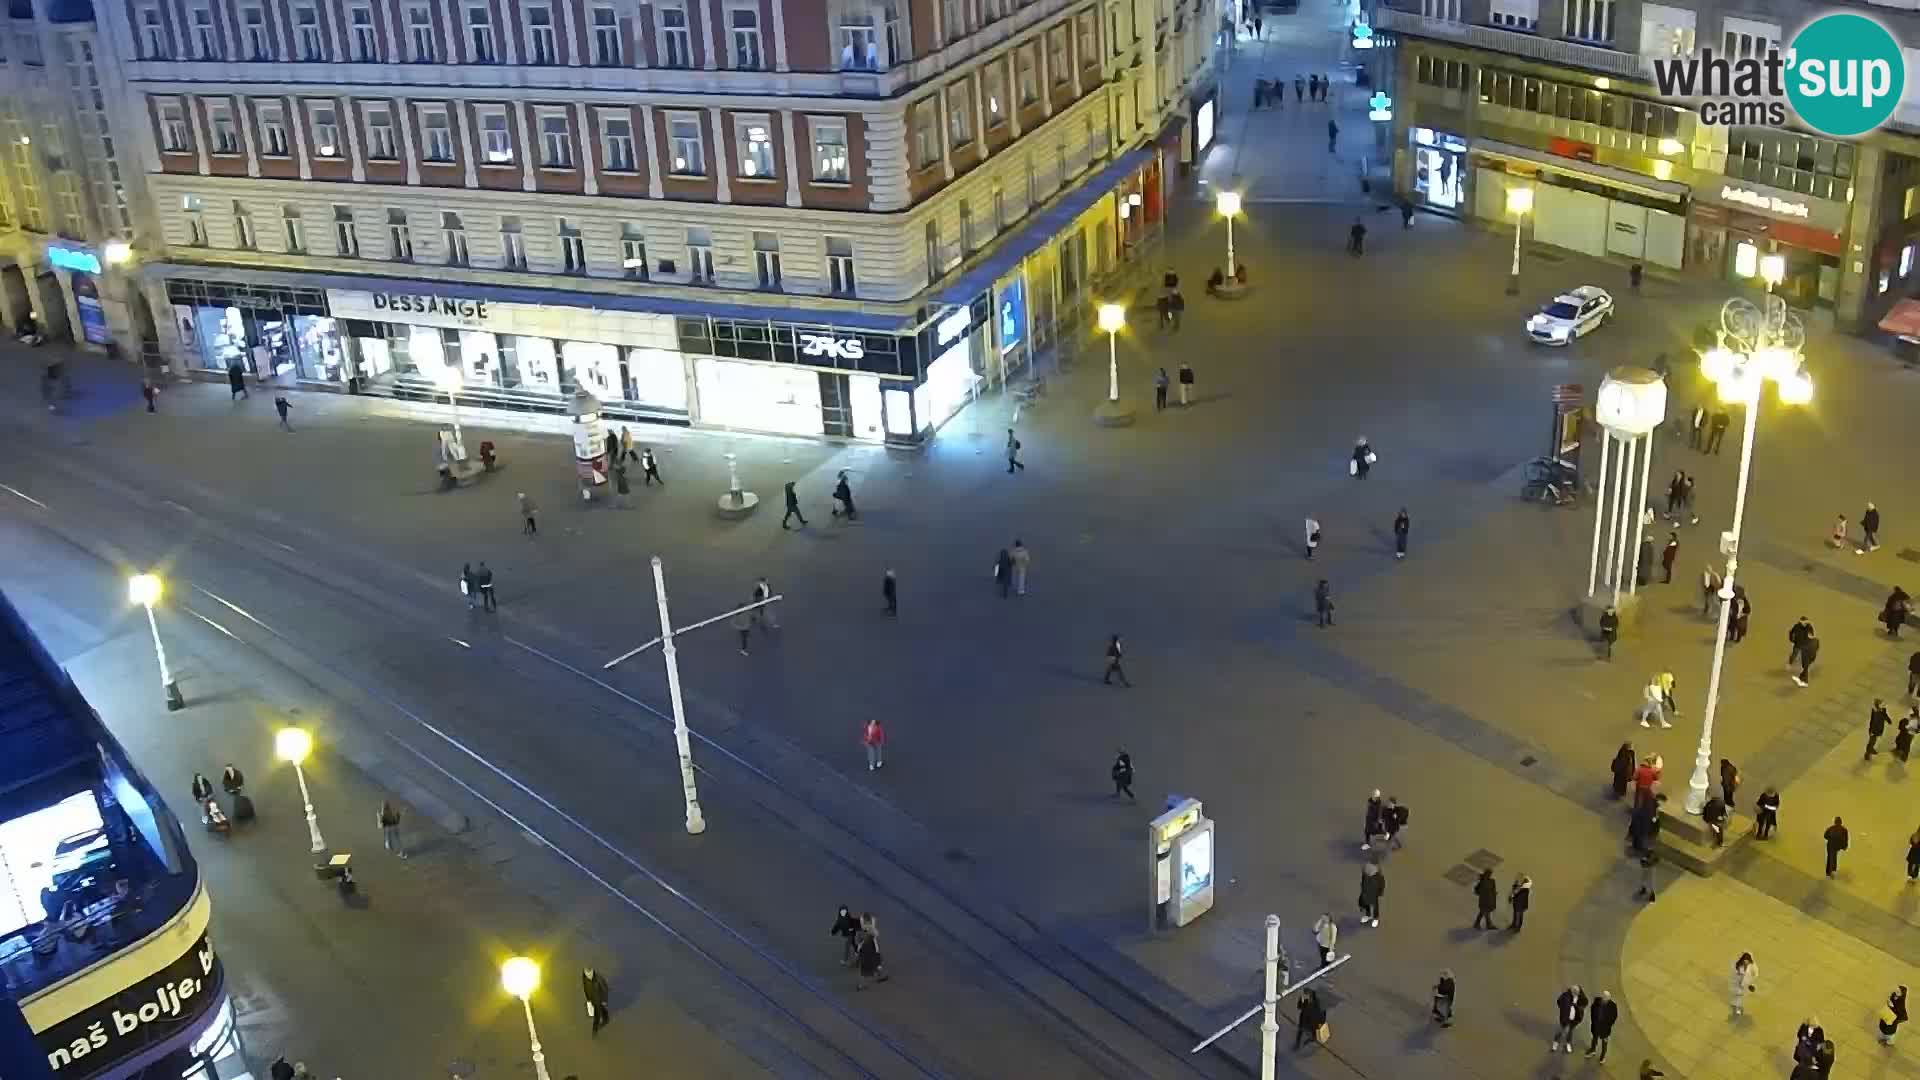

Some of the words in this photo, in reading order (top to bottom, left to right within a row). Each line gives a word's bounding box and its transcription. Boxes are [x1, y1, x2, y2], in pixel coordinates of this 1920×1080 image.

[372, 292, 489, 320] DESSANGE
[47, 1020, 109, 1071] naš
[111, 976, 202, 1037] bolje,
